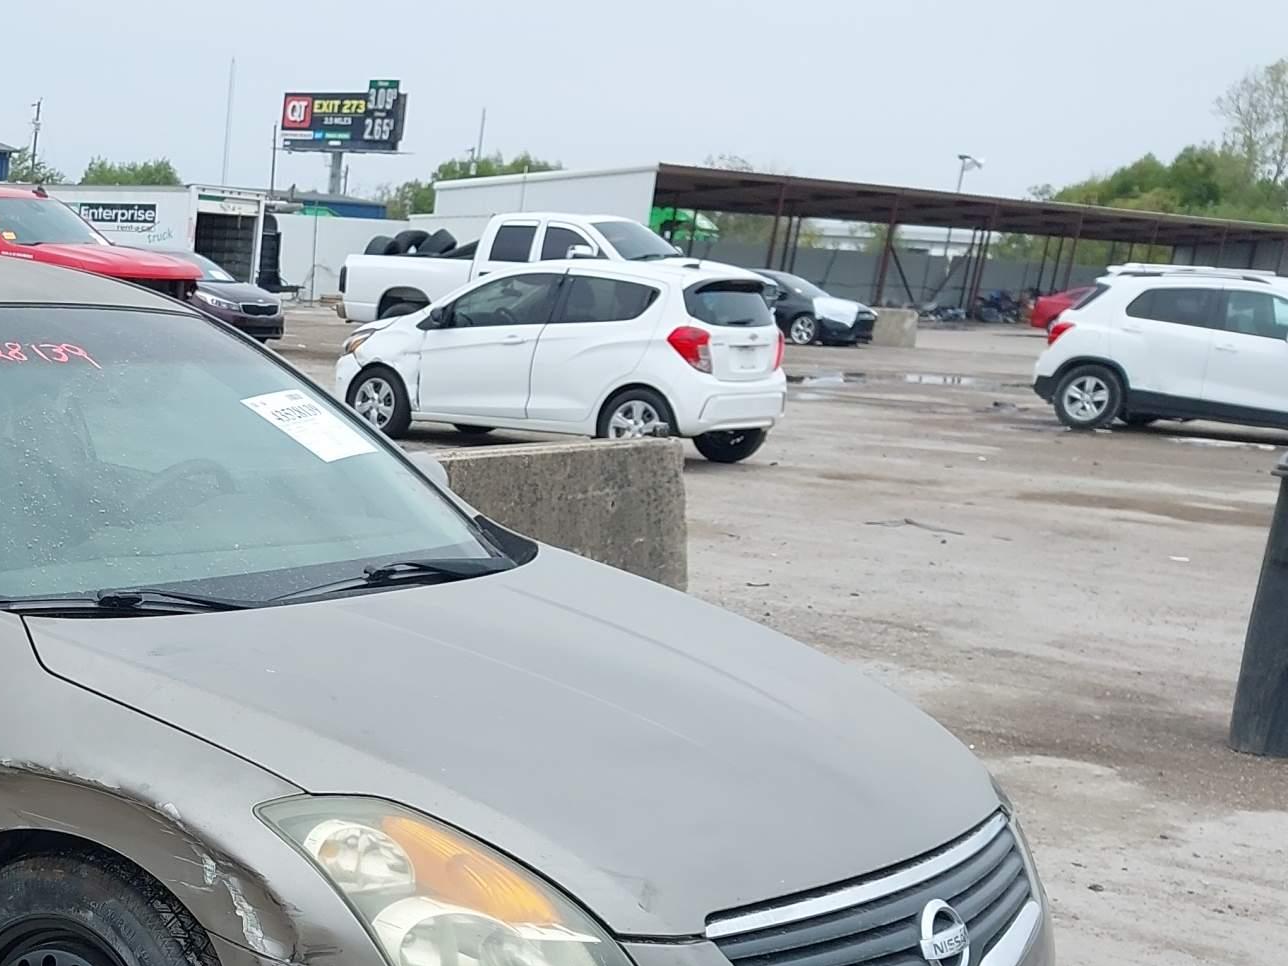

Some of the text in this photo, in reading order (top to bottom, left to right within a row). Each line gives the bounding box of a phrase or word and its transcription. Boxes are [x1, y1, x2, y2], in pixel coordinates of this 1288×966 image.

[287, 100, 308, 122] QT
[312, 100, 366, 113] EXIT 273
[80, 205, 155, 223] Enterprise
[147, 227, 174, 244] truck
